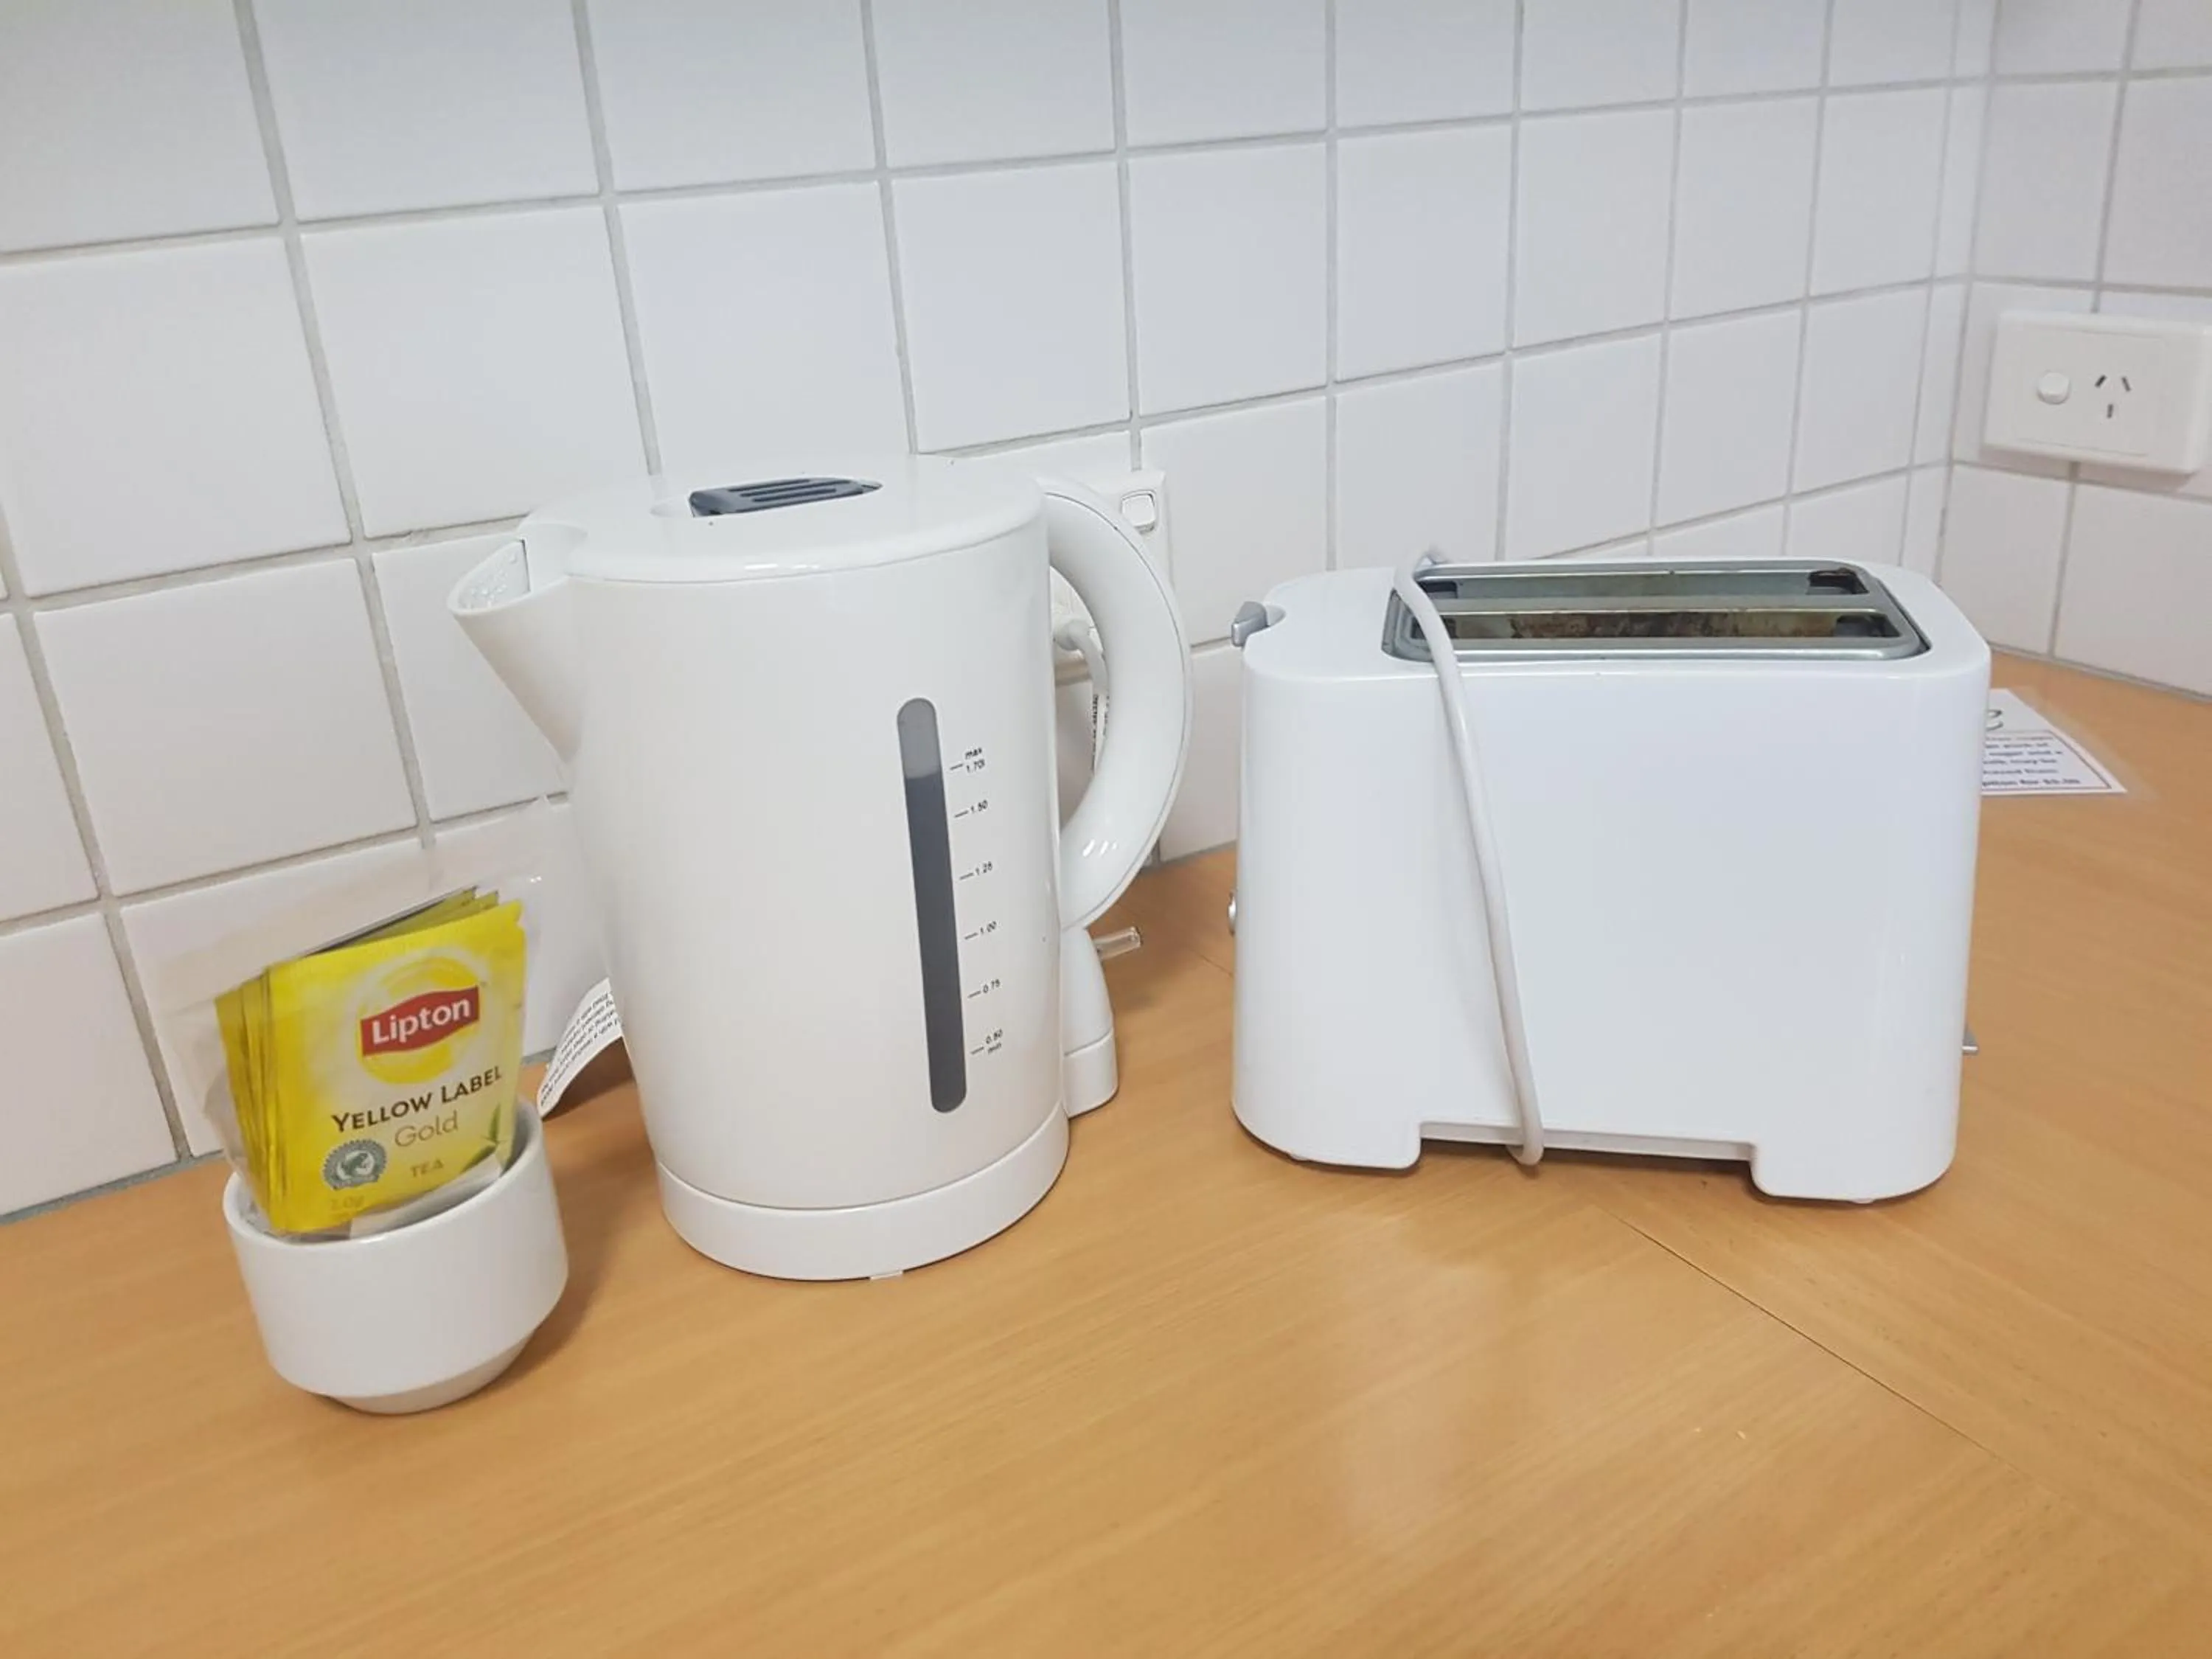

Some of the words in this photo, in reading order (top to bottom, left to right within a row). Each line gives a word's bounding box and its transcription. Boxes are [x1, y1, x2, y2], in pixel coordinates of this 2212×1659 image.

[372, 998, 470, 1046] Lipton
[332, 1091, 433, 1133] YELLOW
[441, 1065, 502, 1104] LABEL
[394, 1110, 459, 1148] Gold
[410, 1158, 445, 1178] TEA
